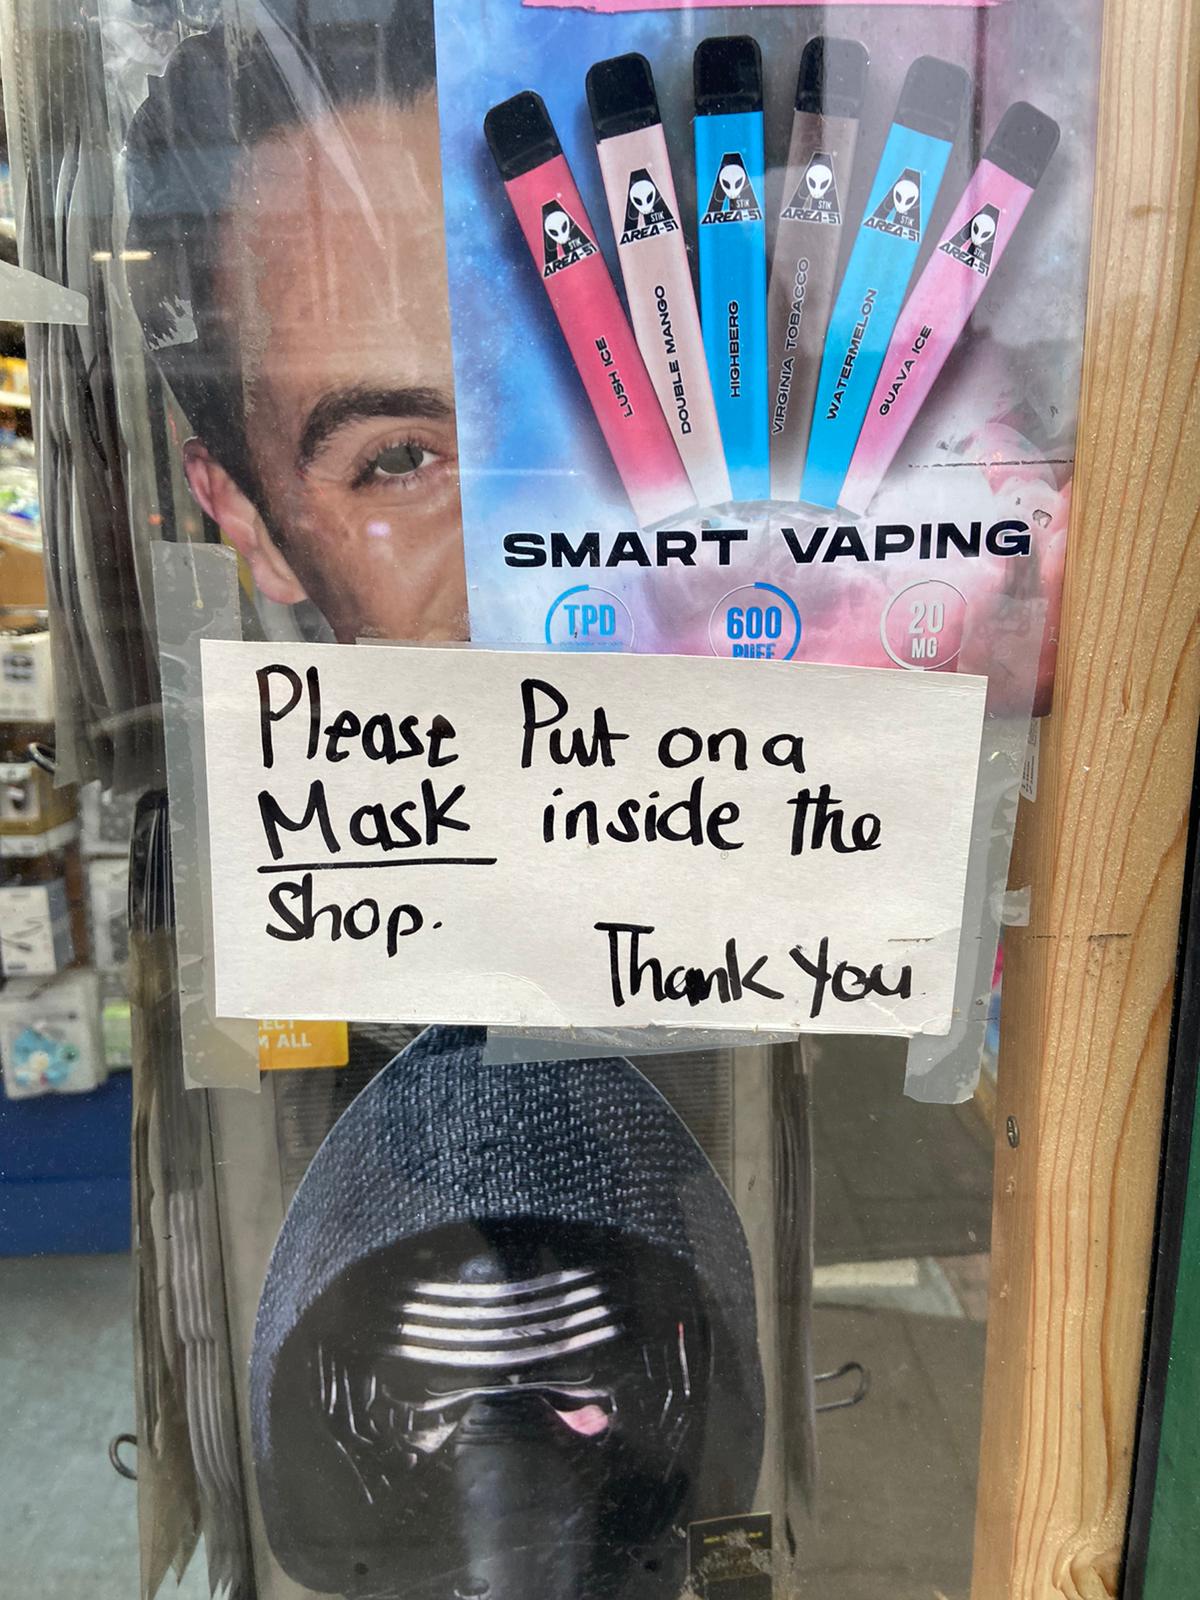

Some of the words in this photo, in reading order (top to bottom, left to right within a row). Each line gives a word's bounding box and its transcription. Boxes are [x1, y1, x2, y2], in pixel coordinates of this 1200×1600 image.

[619, 219, 680, 245] AREA-51
[701, 208, 763, 225] AREA-51
[781, 207, 842, 225] AREA-51
[863, 217, 921, 242] AREA-51
[542, 244, 598, 278] AREA-51
[938, 241, 990, 278] AREA-51
[654, 285, 677, 354] MANGO
[595, 336, 613, 367] ICE
[728, 301, 741, 398] HIGHBERG
[772, 358, 794, 434] VIRGINIA
[786, 259, 809, 350] TOBACCO
[827, 289, 878, 420] WATERMELON
[879, 360, 915, 416] GUAVA
[912, 325, 932, 354] ICE
[608, 371, 634, 418] LUSH
[669, 359, 692, 435] DOUBLE
[502, 529, 749, 568] SMART
[781, 519, 1032, 564] VAPING
[564, 604, 616, 637] TPD
[727, 606, 782, 639] 600
[908, 600, 945, 634] 20
[911, 637, 938, 658] MG
[256, 664, 459, 769] Please
[520, 678, 630, 769] Put
[657, 726, 748, 770] on
[762, 733, 806, 774] a
[257, 778, 471, 861] Mask
[543, 776, 745, 852] inside
[787, 783, 882, 856] the
[593, 921, 785, 1007] Thank
[277, 1032, 312, 1048] ALL
